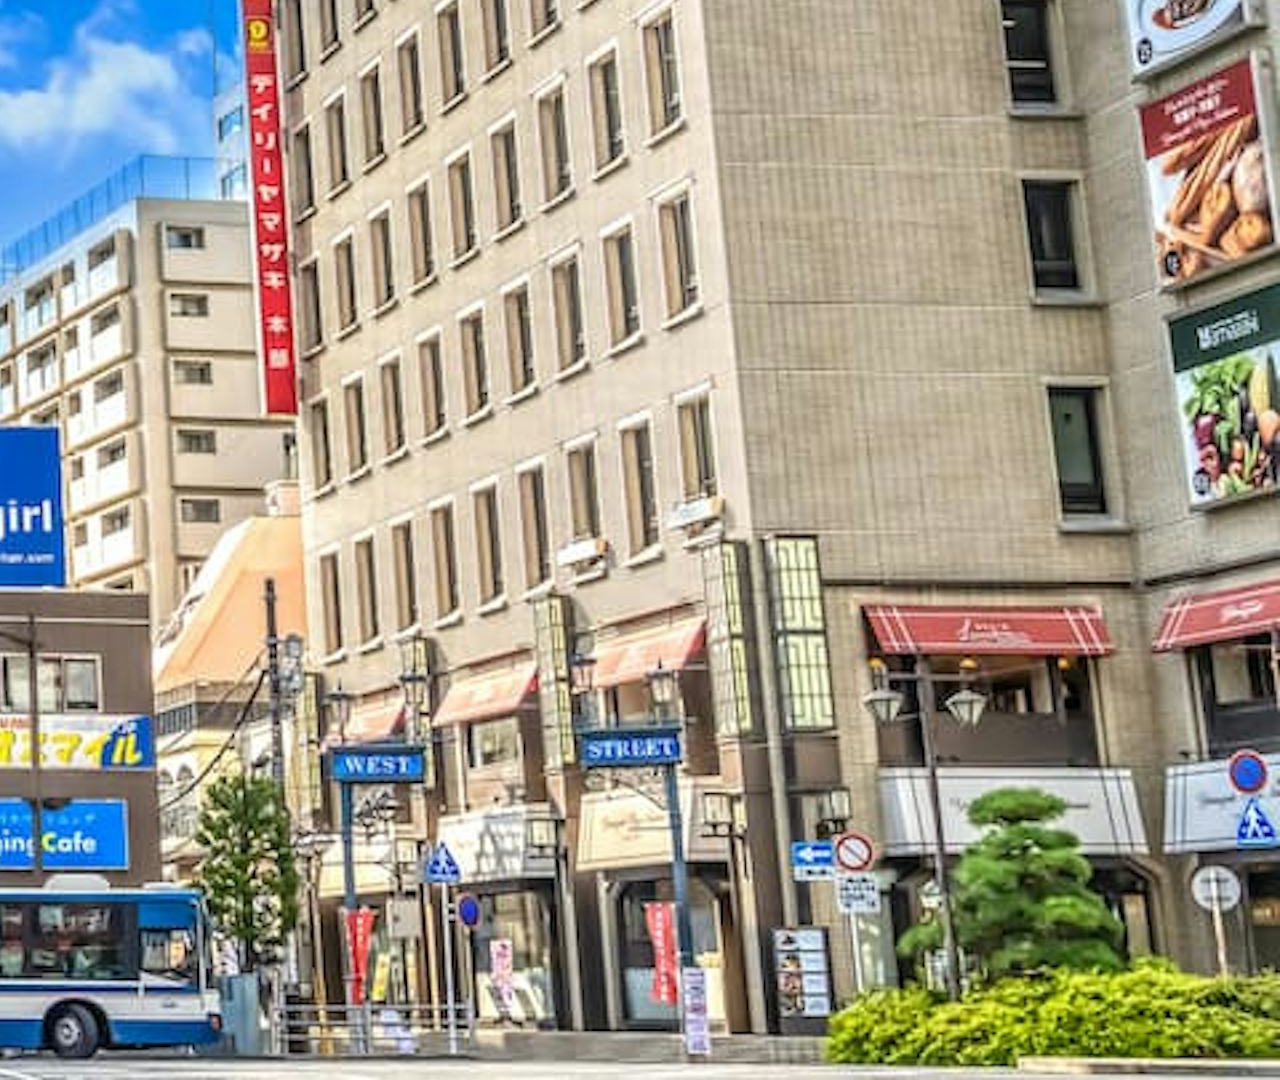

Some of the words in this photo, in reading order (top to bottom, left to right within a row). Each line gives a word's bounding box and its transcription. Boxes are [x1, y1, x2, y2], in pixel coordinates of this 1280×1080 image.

[588, 735, 678, 759] STREET
[343, 755, 412, 775] WEST
[42, 830, 97, 852] Cafe
